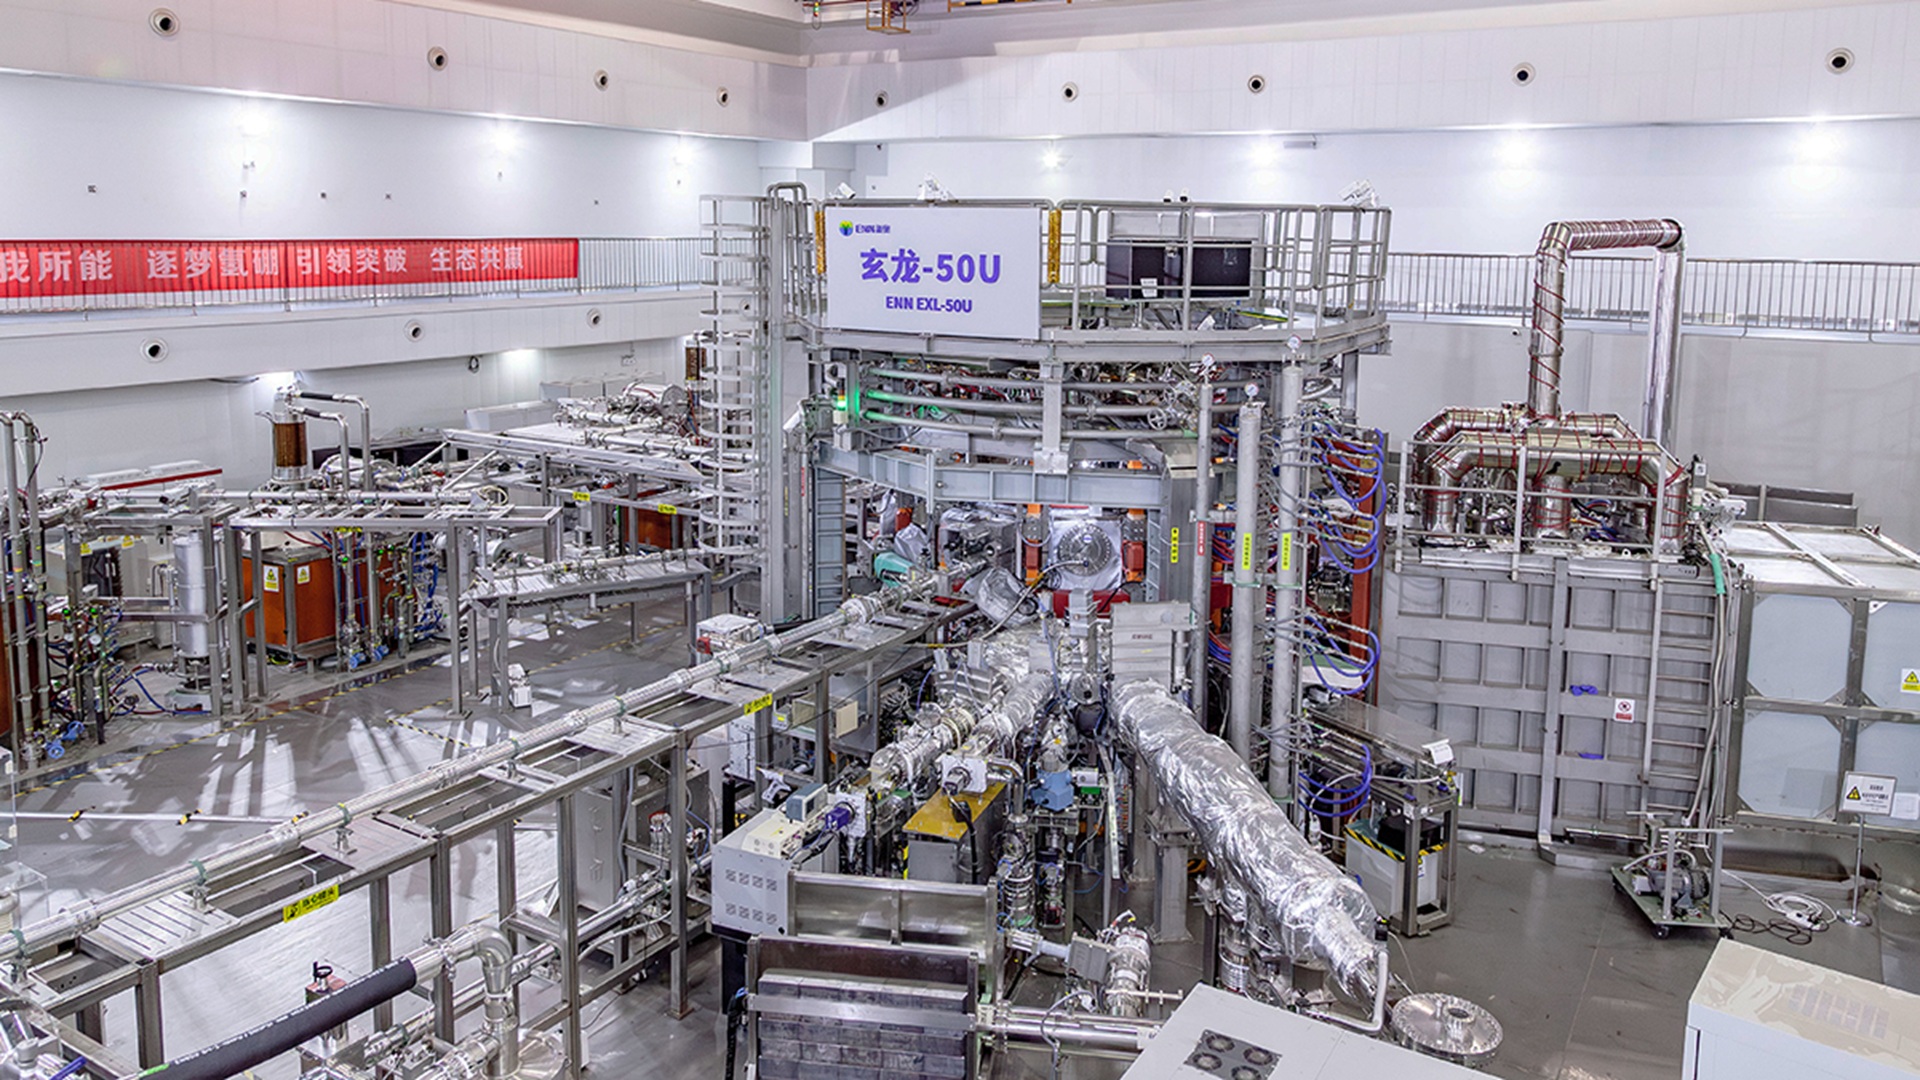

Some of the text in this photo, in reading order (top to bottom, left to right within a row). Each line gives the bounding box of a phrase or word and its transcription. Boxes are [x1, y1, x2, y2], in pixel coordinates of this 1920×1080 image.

[0, 250, 113, 283] 我所能
[296, 247, 407, 275] 引领突破
[430, 246, 524, 272] 生态共赢
[860, 248, 1001, 284] 玄龙-50U
[886, 296, 973, 313] ENN EXL-50U
